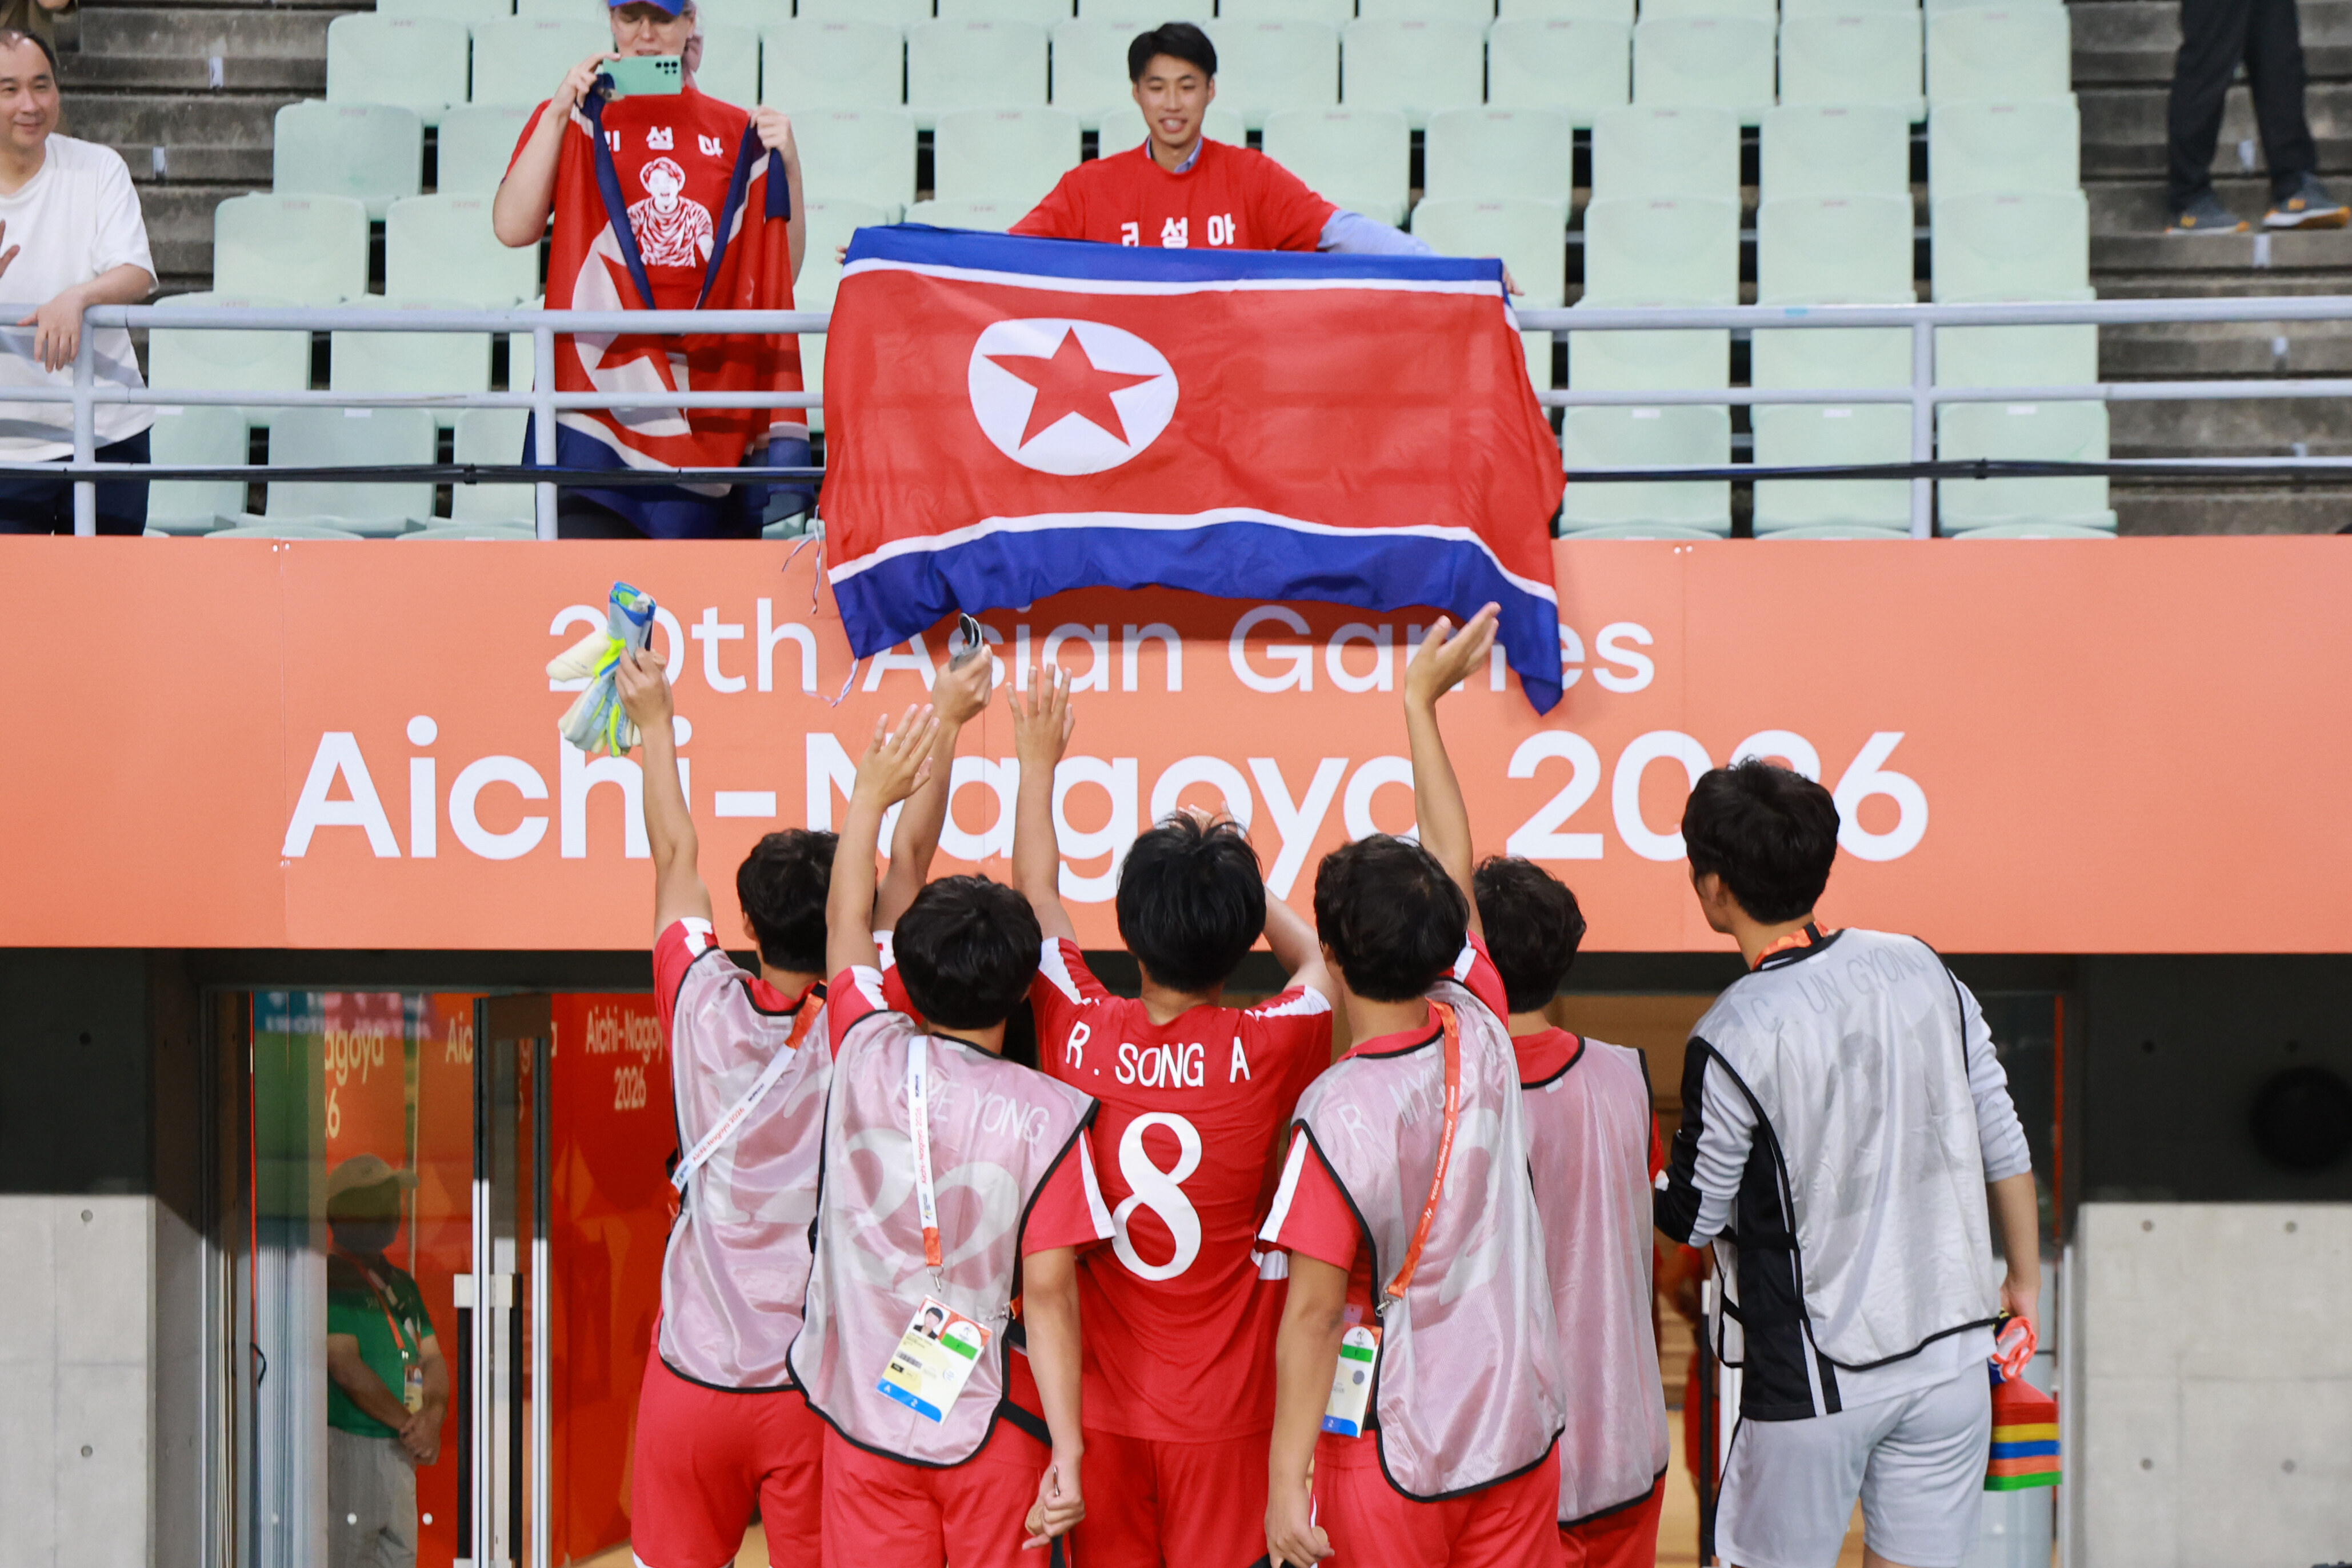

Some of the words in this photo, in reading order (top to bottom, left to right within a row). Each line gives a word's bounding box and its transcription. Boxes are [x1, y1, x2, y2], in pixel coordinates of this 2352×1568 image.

[1506, 730, 1929, 862] 206
[614, 1065, 647, 1110] 2026
[1115, 1042, 1205, 1089] SONG
[1229, 1036, 1251, 1083] A
[970, 1085, 1051, 1145] YONG
[1111, 1111, 1202, 1281] 8
